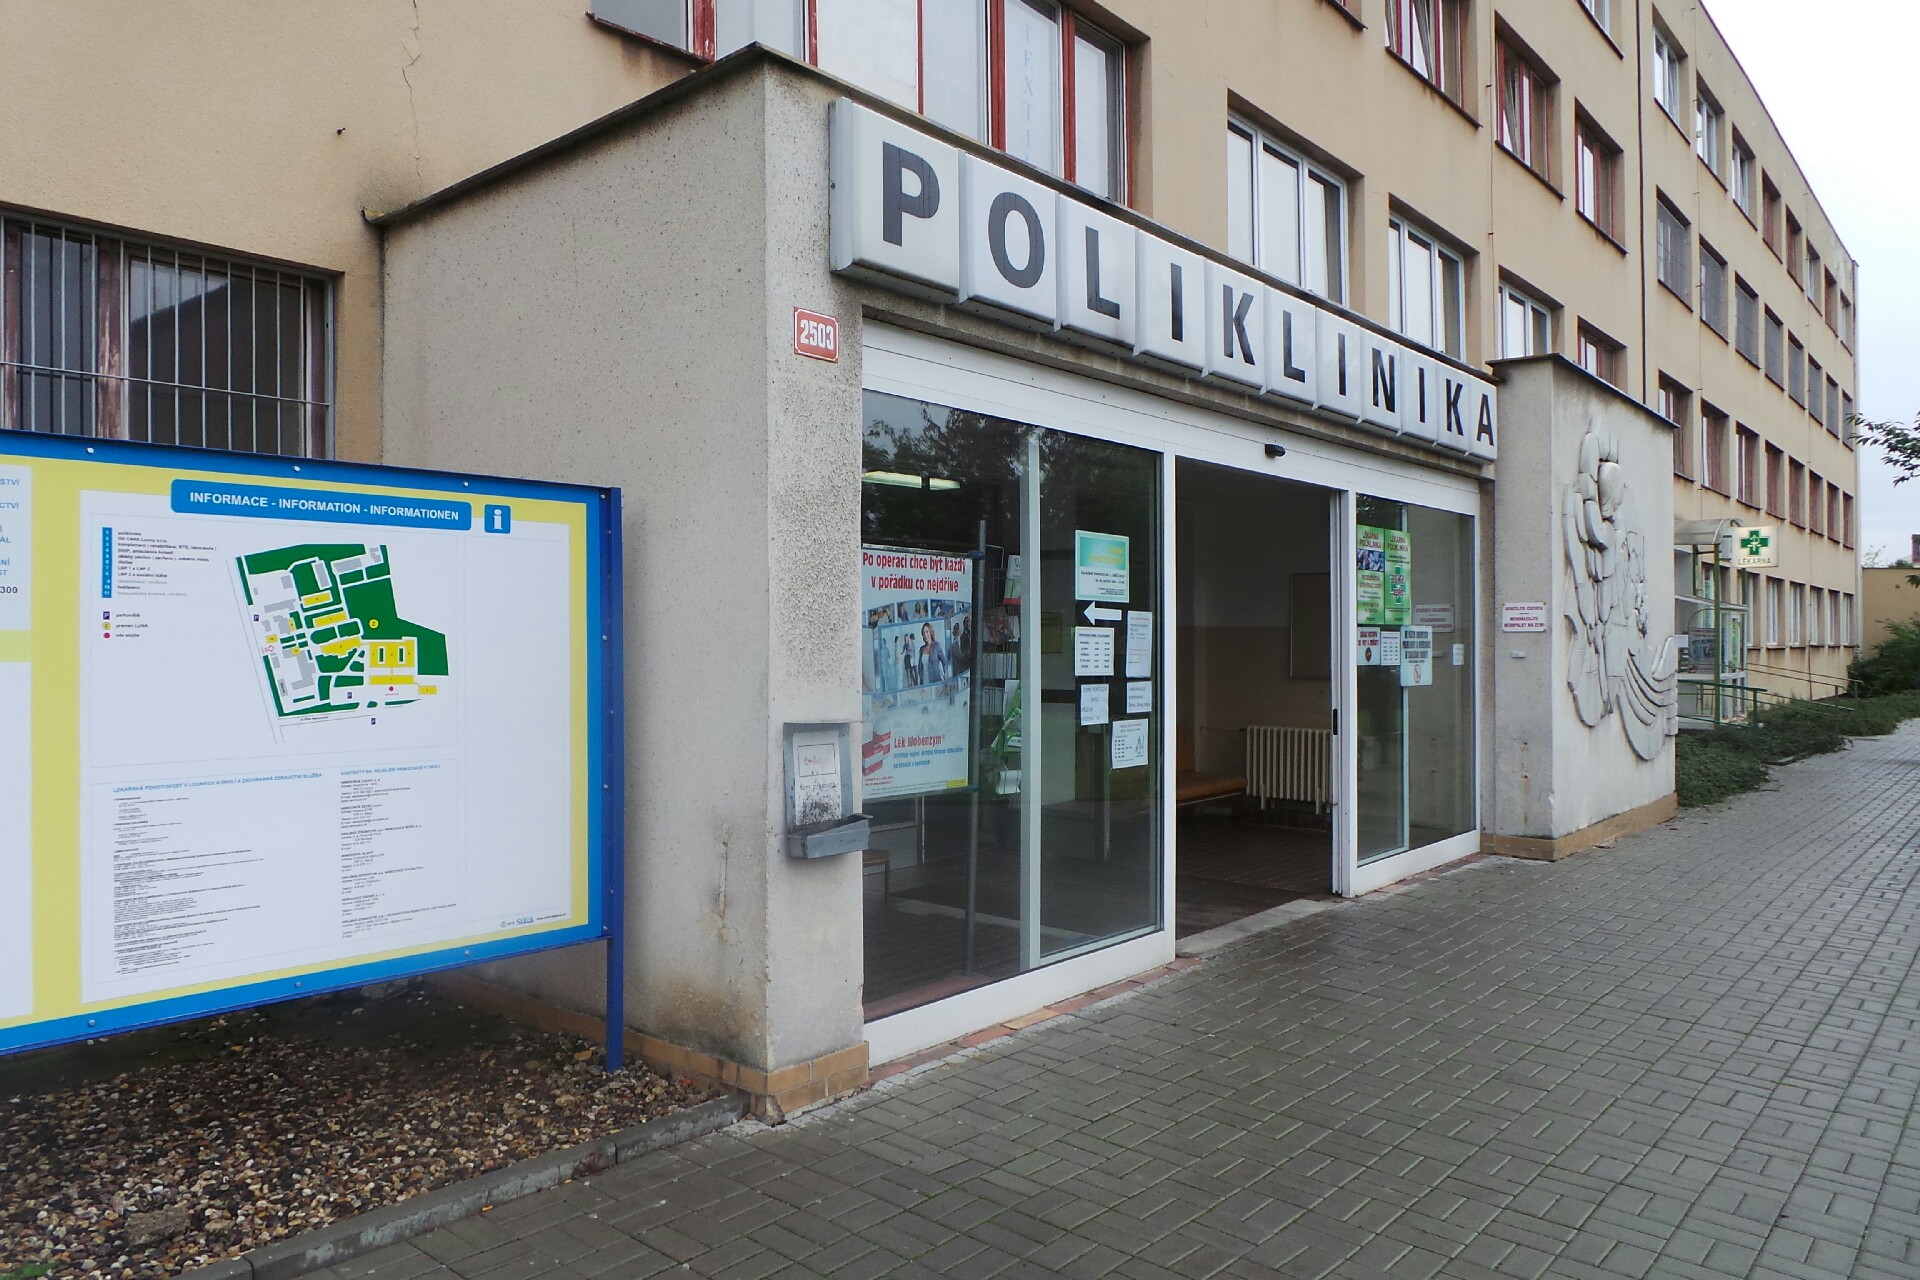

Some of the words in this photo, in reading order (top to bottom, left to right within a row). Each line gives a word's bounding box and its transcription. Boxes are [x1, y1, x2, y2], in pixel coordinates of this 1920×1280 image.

[882, 141, 1494, 446] POLIKLINIKA
[800, 319, 834, 350] 2503
[190, 492, 268, 507] INFORMACE
[279, 499, 360, 513] INFORMATION
[370, 504, 458, 520] INFORMATIONEN
[863, 552, 874, 566] Po
[876, 554, 907, 569] operaci
[910, 555, 928, 570] chce
[930, 556, 942, 572] být
[871, 576, 876, 588] v
[878, 574, 913, 590] pořádku
[916, 578, 924, 590] co
[927, 577, 958, 593] nejdříve
[894, 736, 905, 748] Lék
